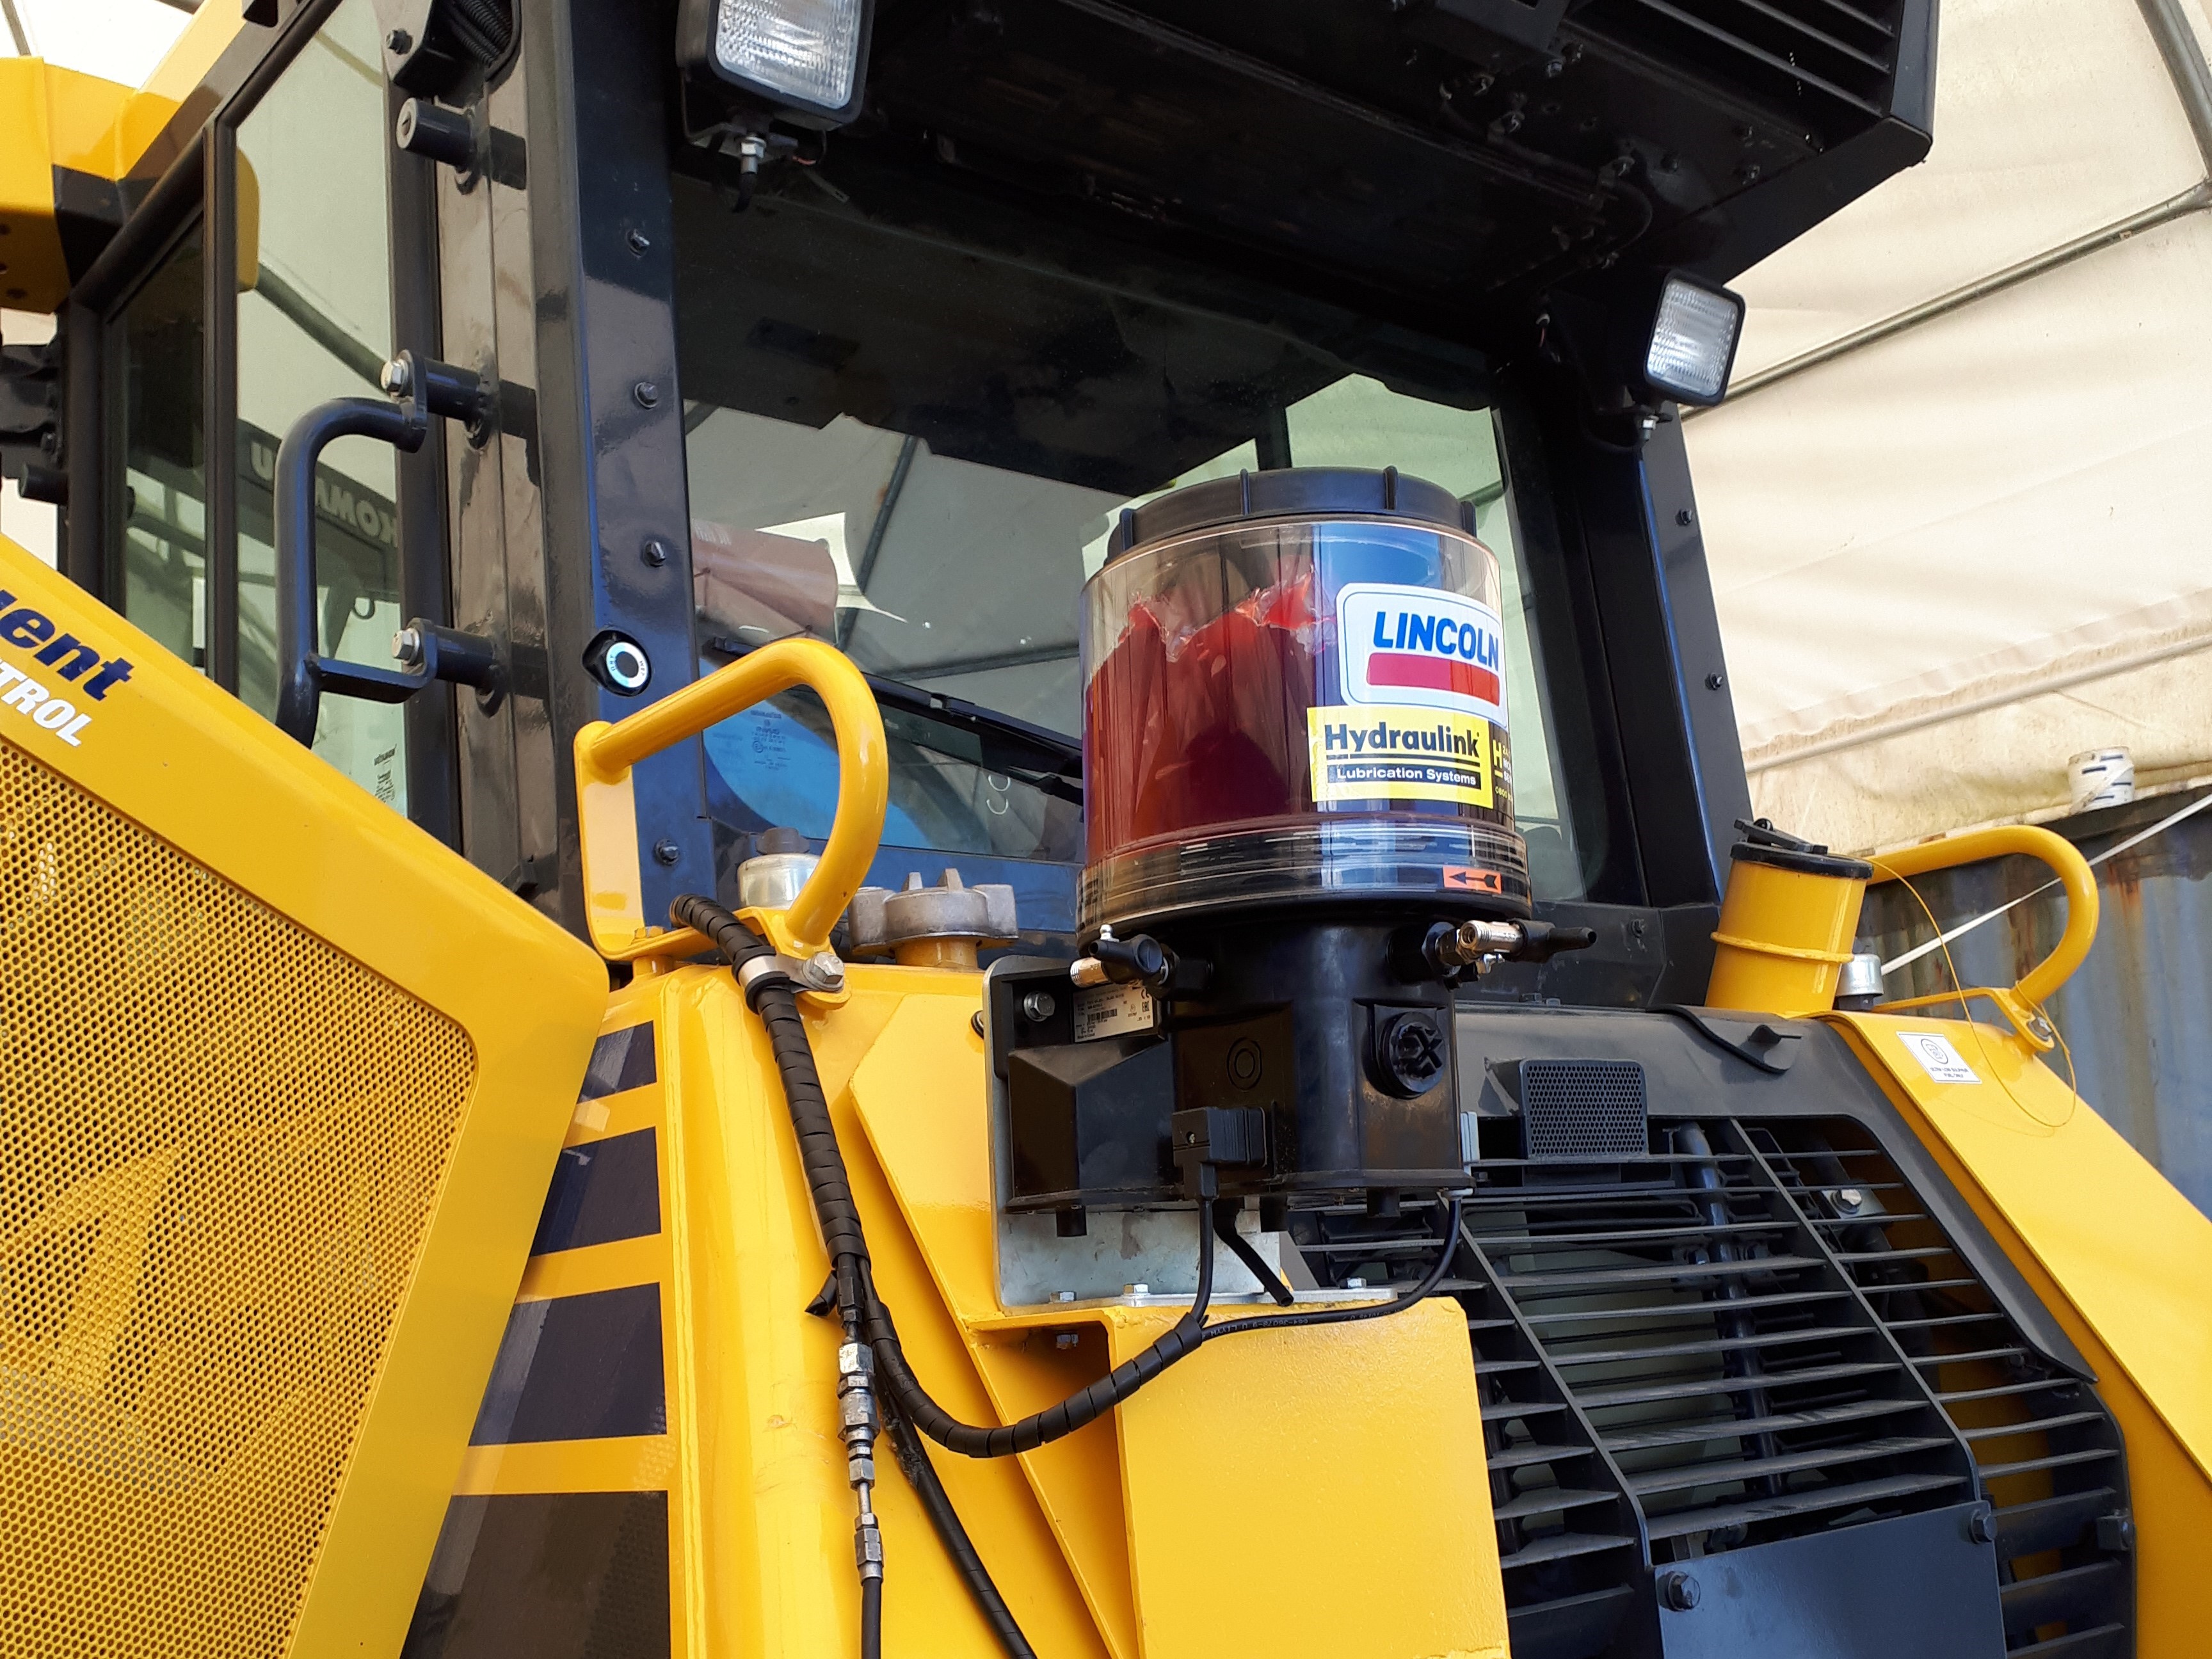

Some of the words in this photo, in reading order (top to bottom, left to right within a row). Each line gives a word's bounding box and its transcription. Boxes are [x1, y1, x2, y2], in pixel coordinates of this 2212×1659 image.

[0, 589, 134, 701] ent
[1374, 611, 1499, 672] LINCOLN
[1324, 721, 1480, 758] Hydraulink
[1336, 767, 1423, 780] Lubrication
[1426, 769, 1476, 786] Systems
